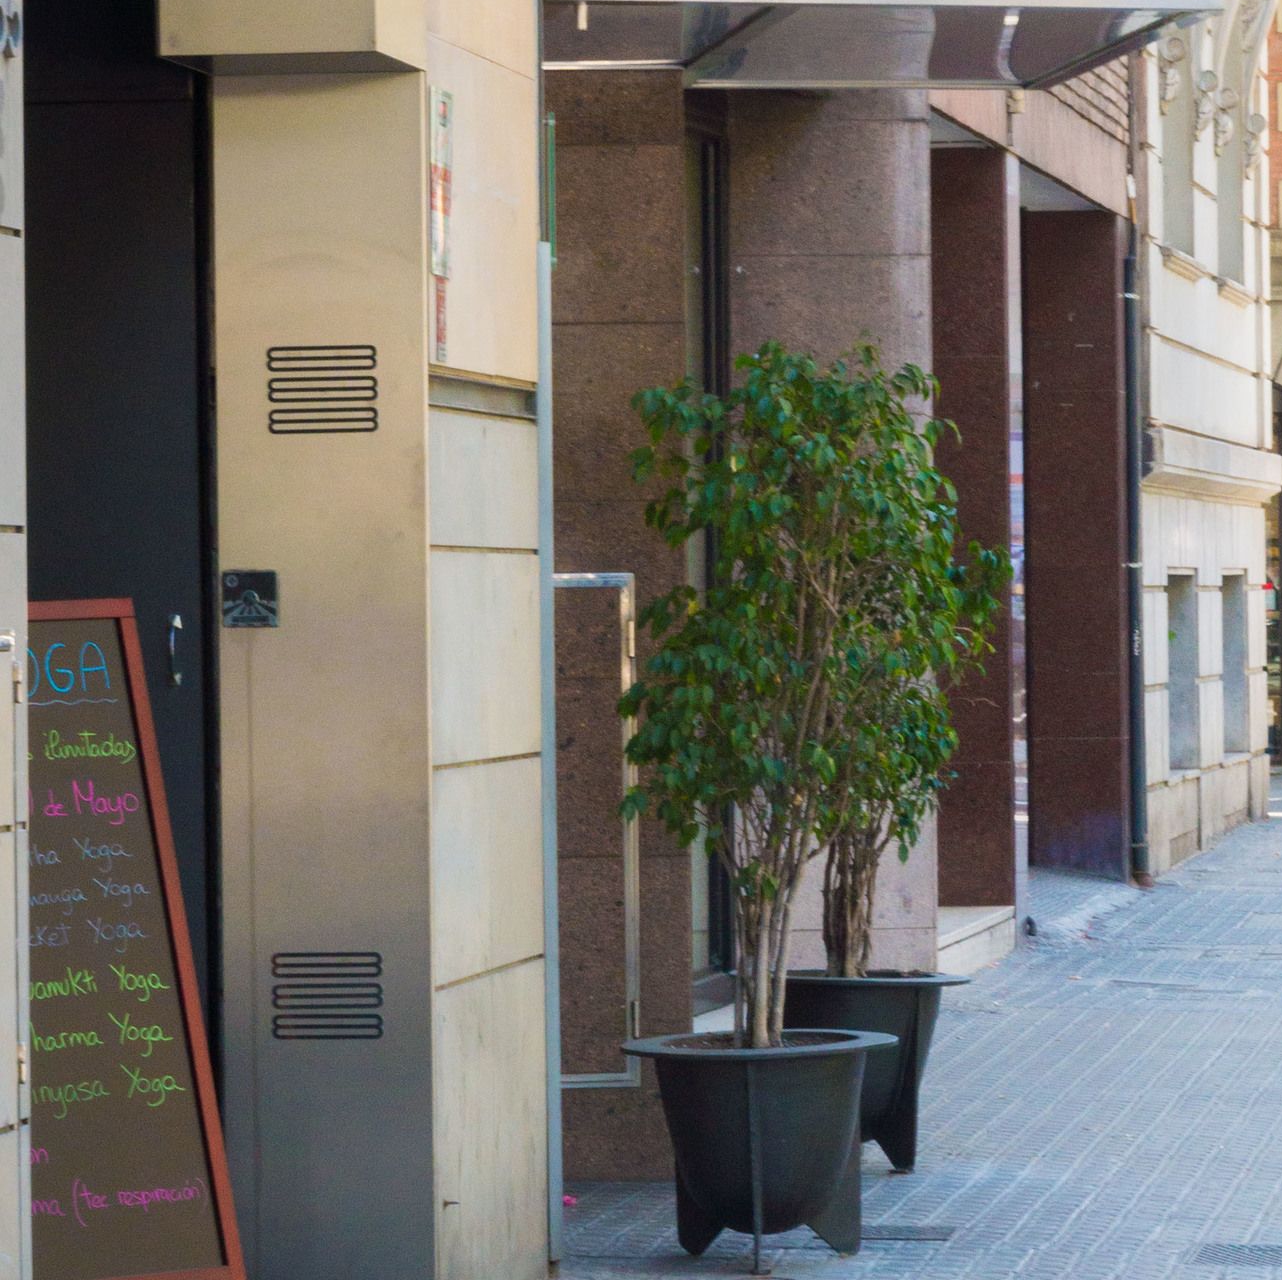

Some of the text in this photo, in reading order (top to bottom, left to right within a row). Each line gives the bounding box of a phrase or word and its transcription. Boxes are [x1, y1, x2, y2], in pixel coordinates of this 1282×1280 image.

[72, 779, 139, 826] Mayo
[71, 836, 134, 873] Yoga
[92, 877, 151, 908] Yoga
[87, 917, 147, 953] Yoga
[107, 963, 171, 1003] Yoga
[29, 1012, 174, 1058] harma Yoga
[31, 1063, 187, 1120] inyasa Yoga
